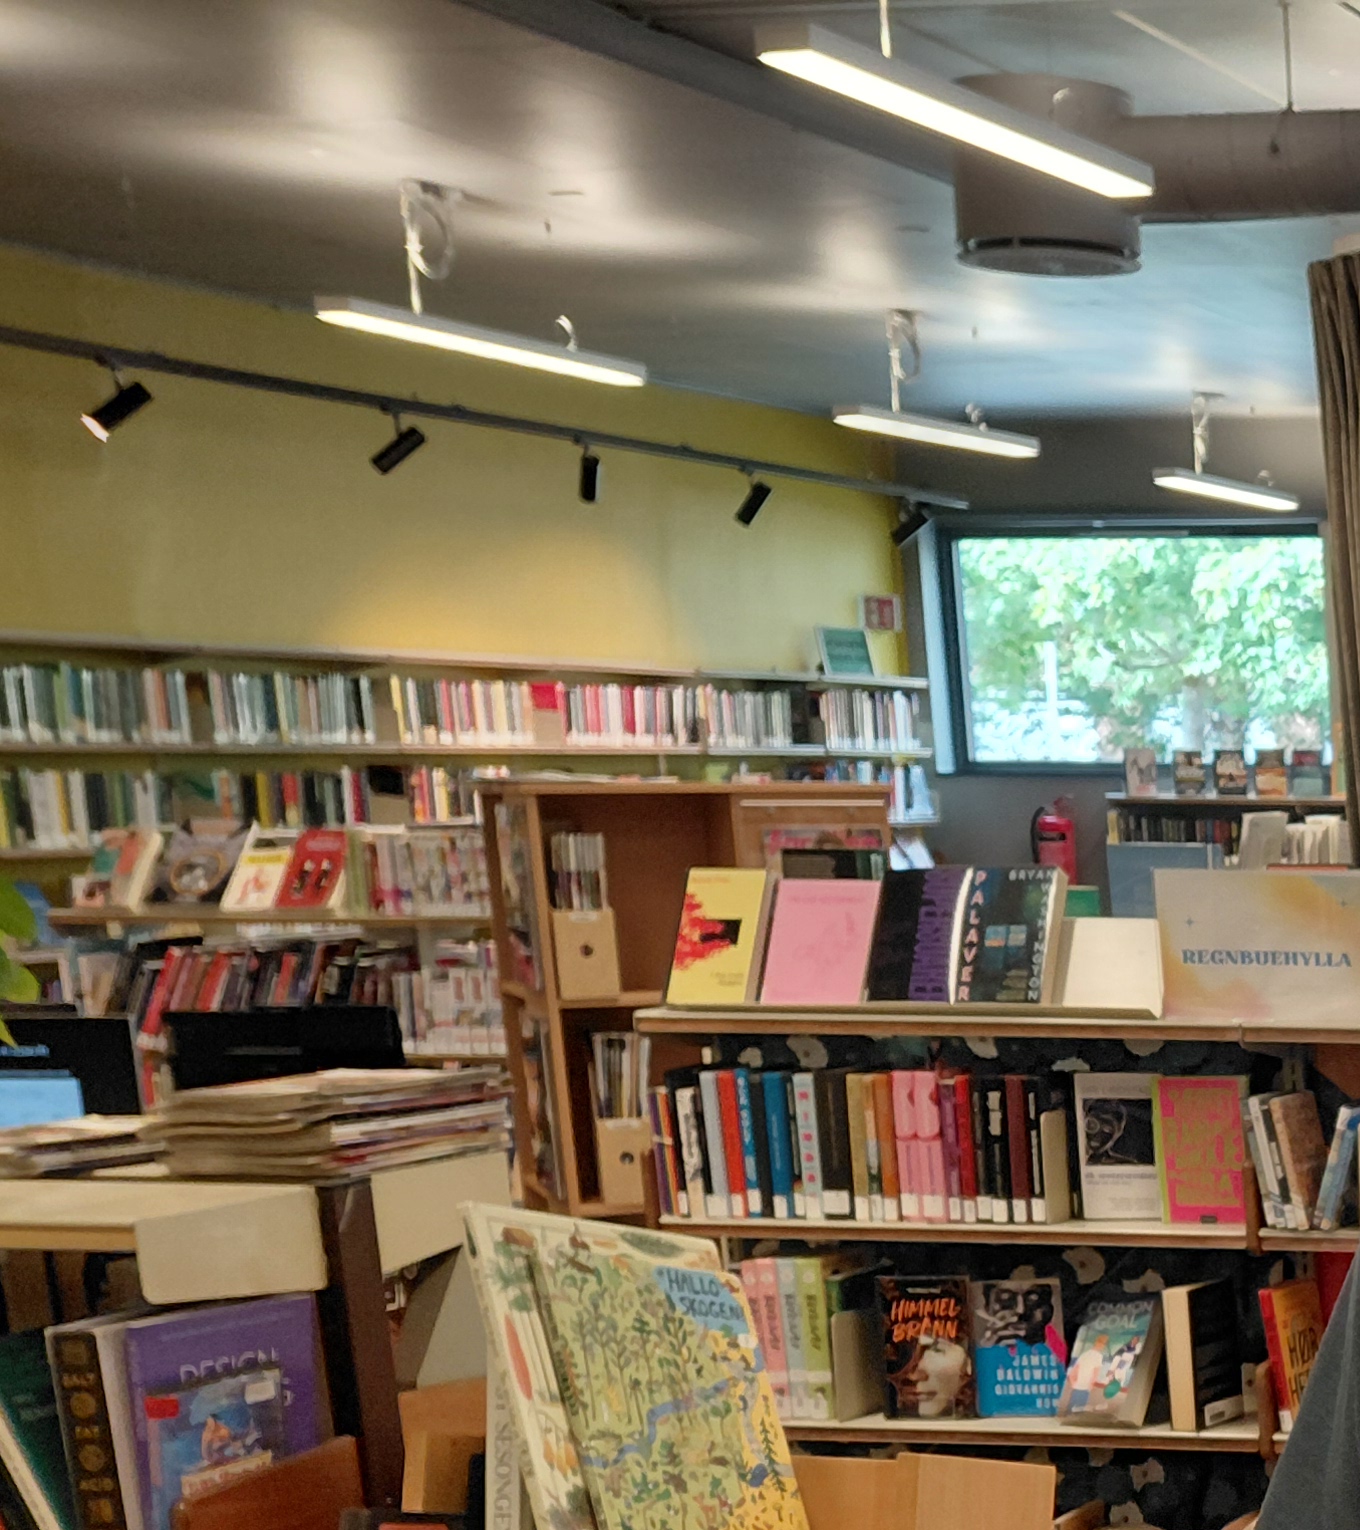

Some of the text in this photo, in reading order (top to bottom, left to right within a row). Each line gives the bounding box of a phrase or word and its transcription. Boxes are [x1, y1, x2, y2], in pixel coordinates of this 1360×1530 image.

[1008, 868, 1055, 881] BRYAN
[957, 870, 988, 1001] PALAVER
[1181, 948, 1353, 968] REGNBUEHYLLA
[666, 1268, 720, 1298] HALLO
[890, 1298, 960, 1322] HIMMEL
[1094, 1314, 1137, 1329] GOAL
[996, 1367, 1059, 1382] BALDWIN
